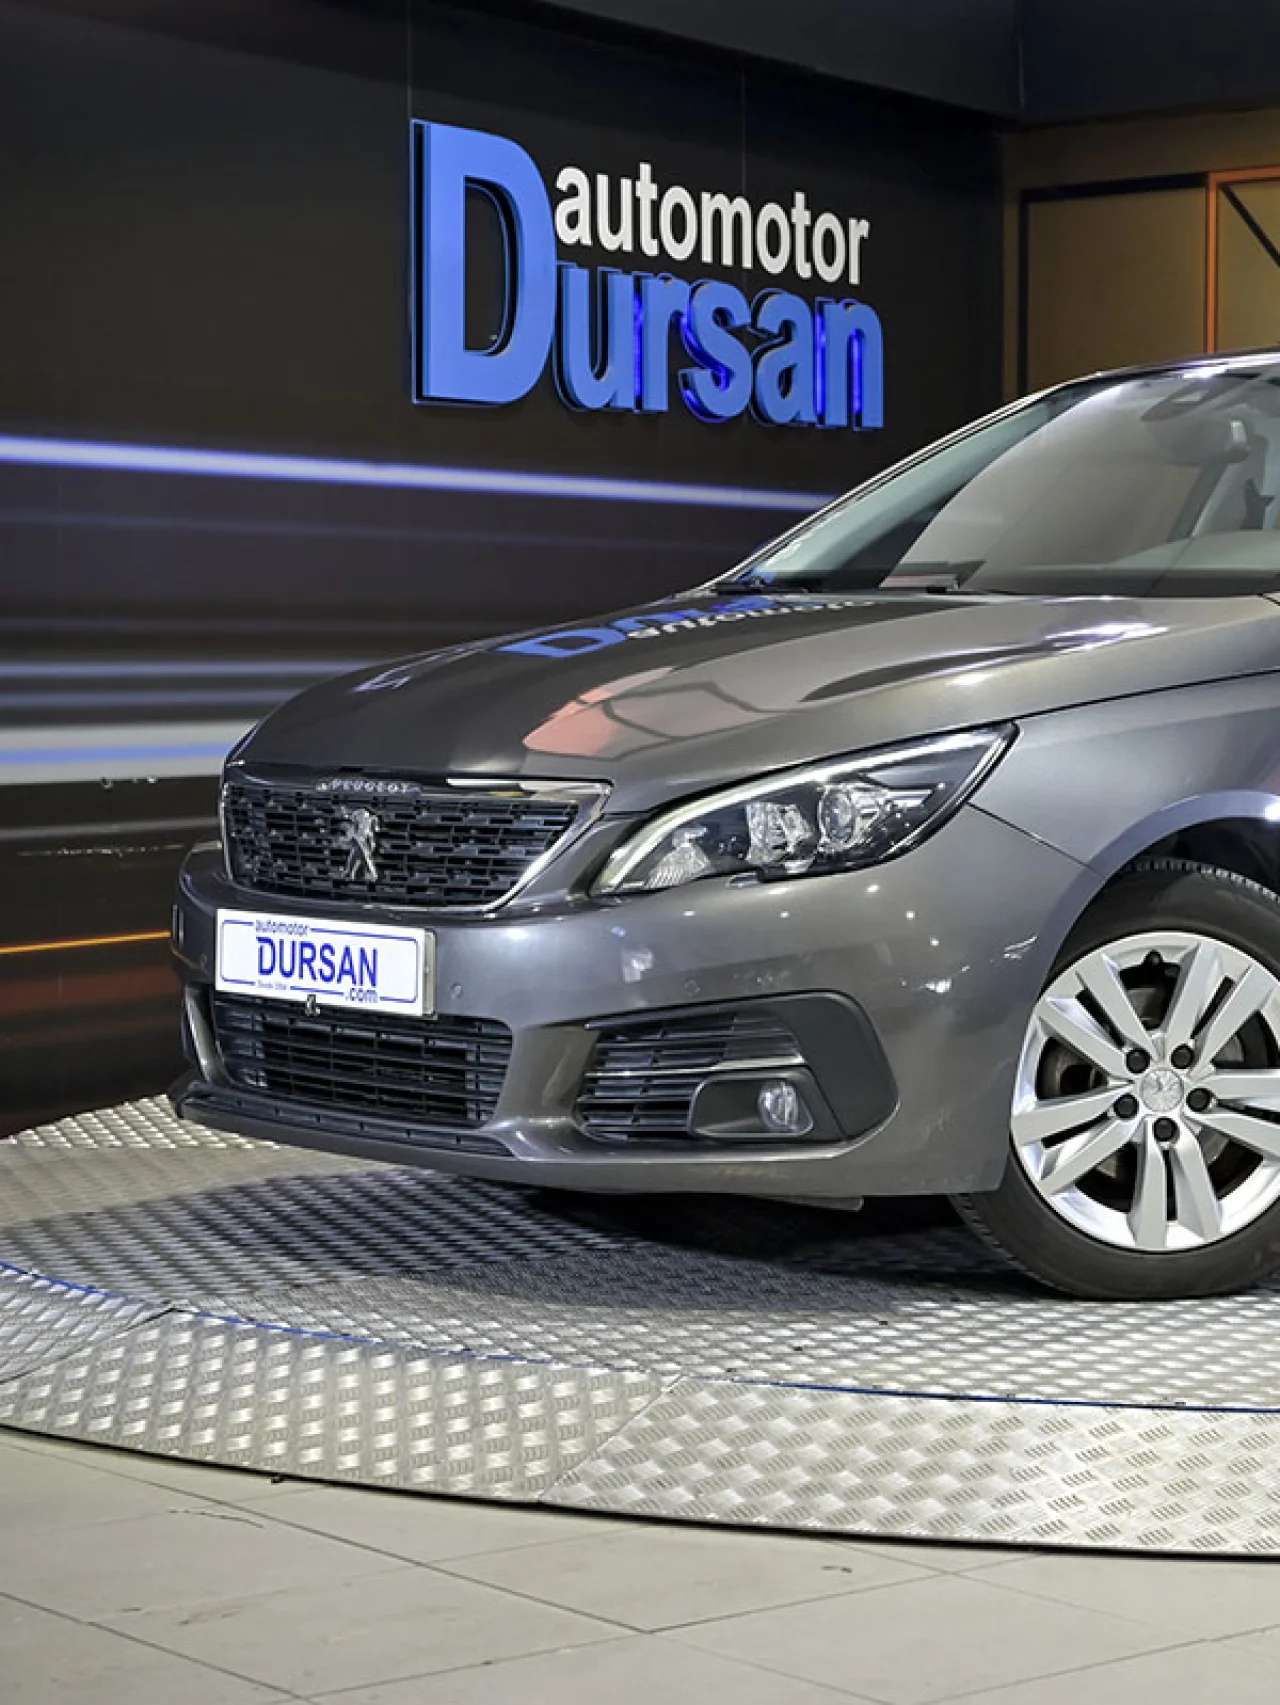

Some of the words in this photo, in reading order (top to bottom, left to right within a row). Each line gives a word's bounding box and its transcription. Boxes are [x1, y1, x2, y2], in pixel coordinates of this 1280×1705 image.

[555, 162, 870, 285] automotor
[410, 118, 884, 430] Dursan
[331, 777, 409, 796] PEUGEOT
[255, 919, 310, 937] automotor
[256, 936, 379, 988] DURSAN
[344, 987, 379, 1004] .com
